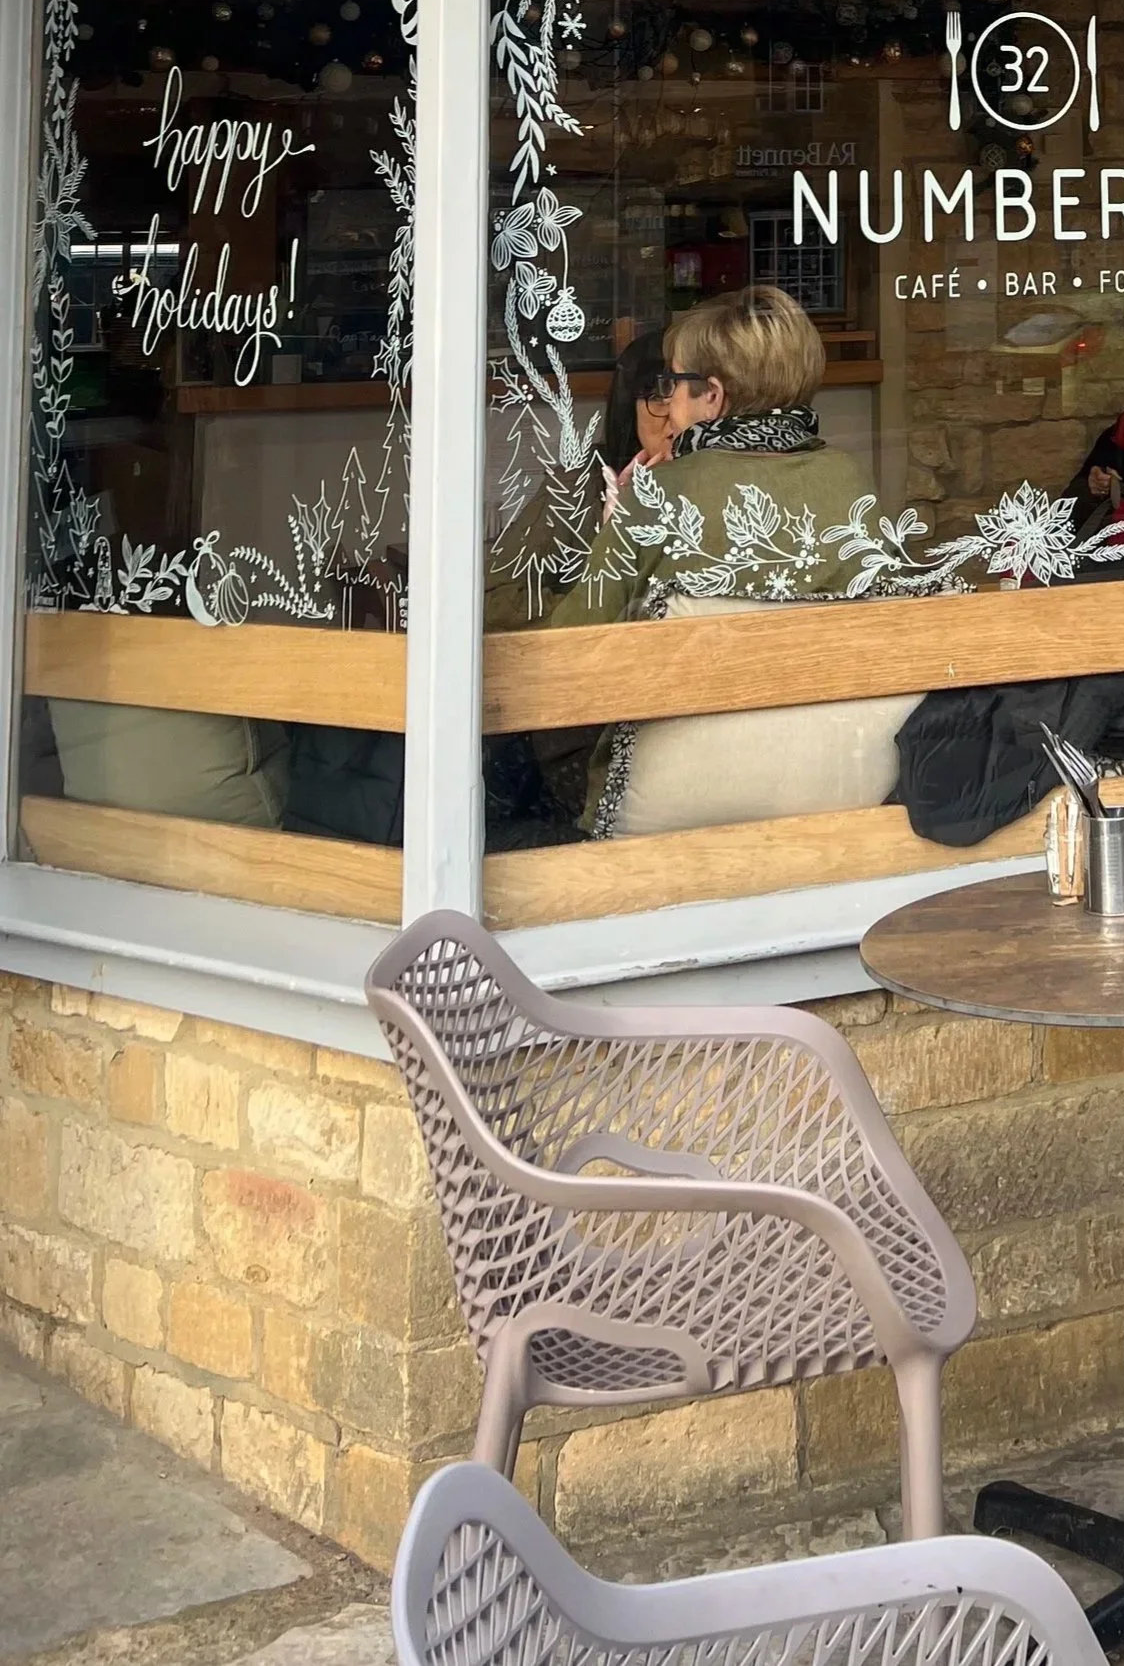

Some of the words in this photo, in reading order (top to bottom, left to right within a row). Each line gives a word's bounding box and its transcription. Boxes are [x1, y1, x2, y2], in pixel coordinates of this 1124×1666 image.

[1001, 45, 1049, 92] 32
[143, 66, 316, 218] happy
[118, 213, 299, 387] holidays!
[895, 266, 961, 300] CAFÉ
[1005, 271, 1056, 296] BAR
